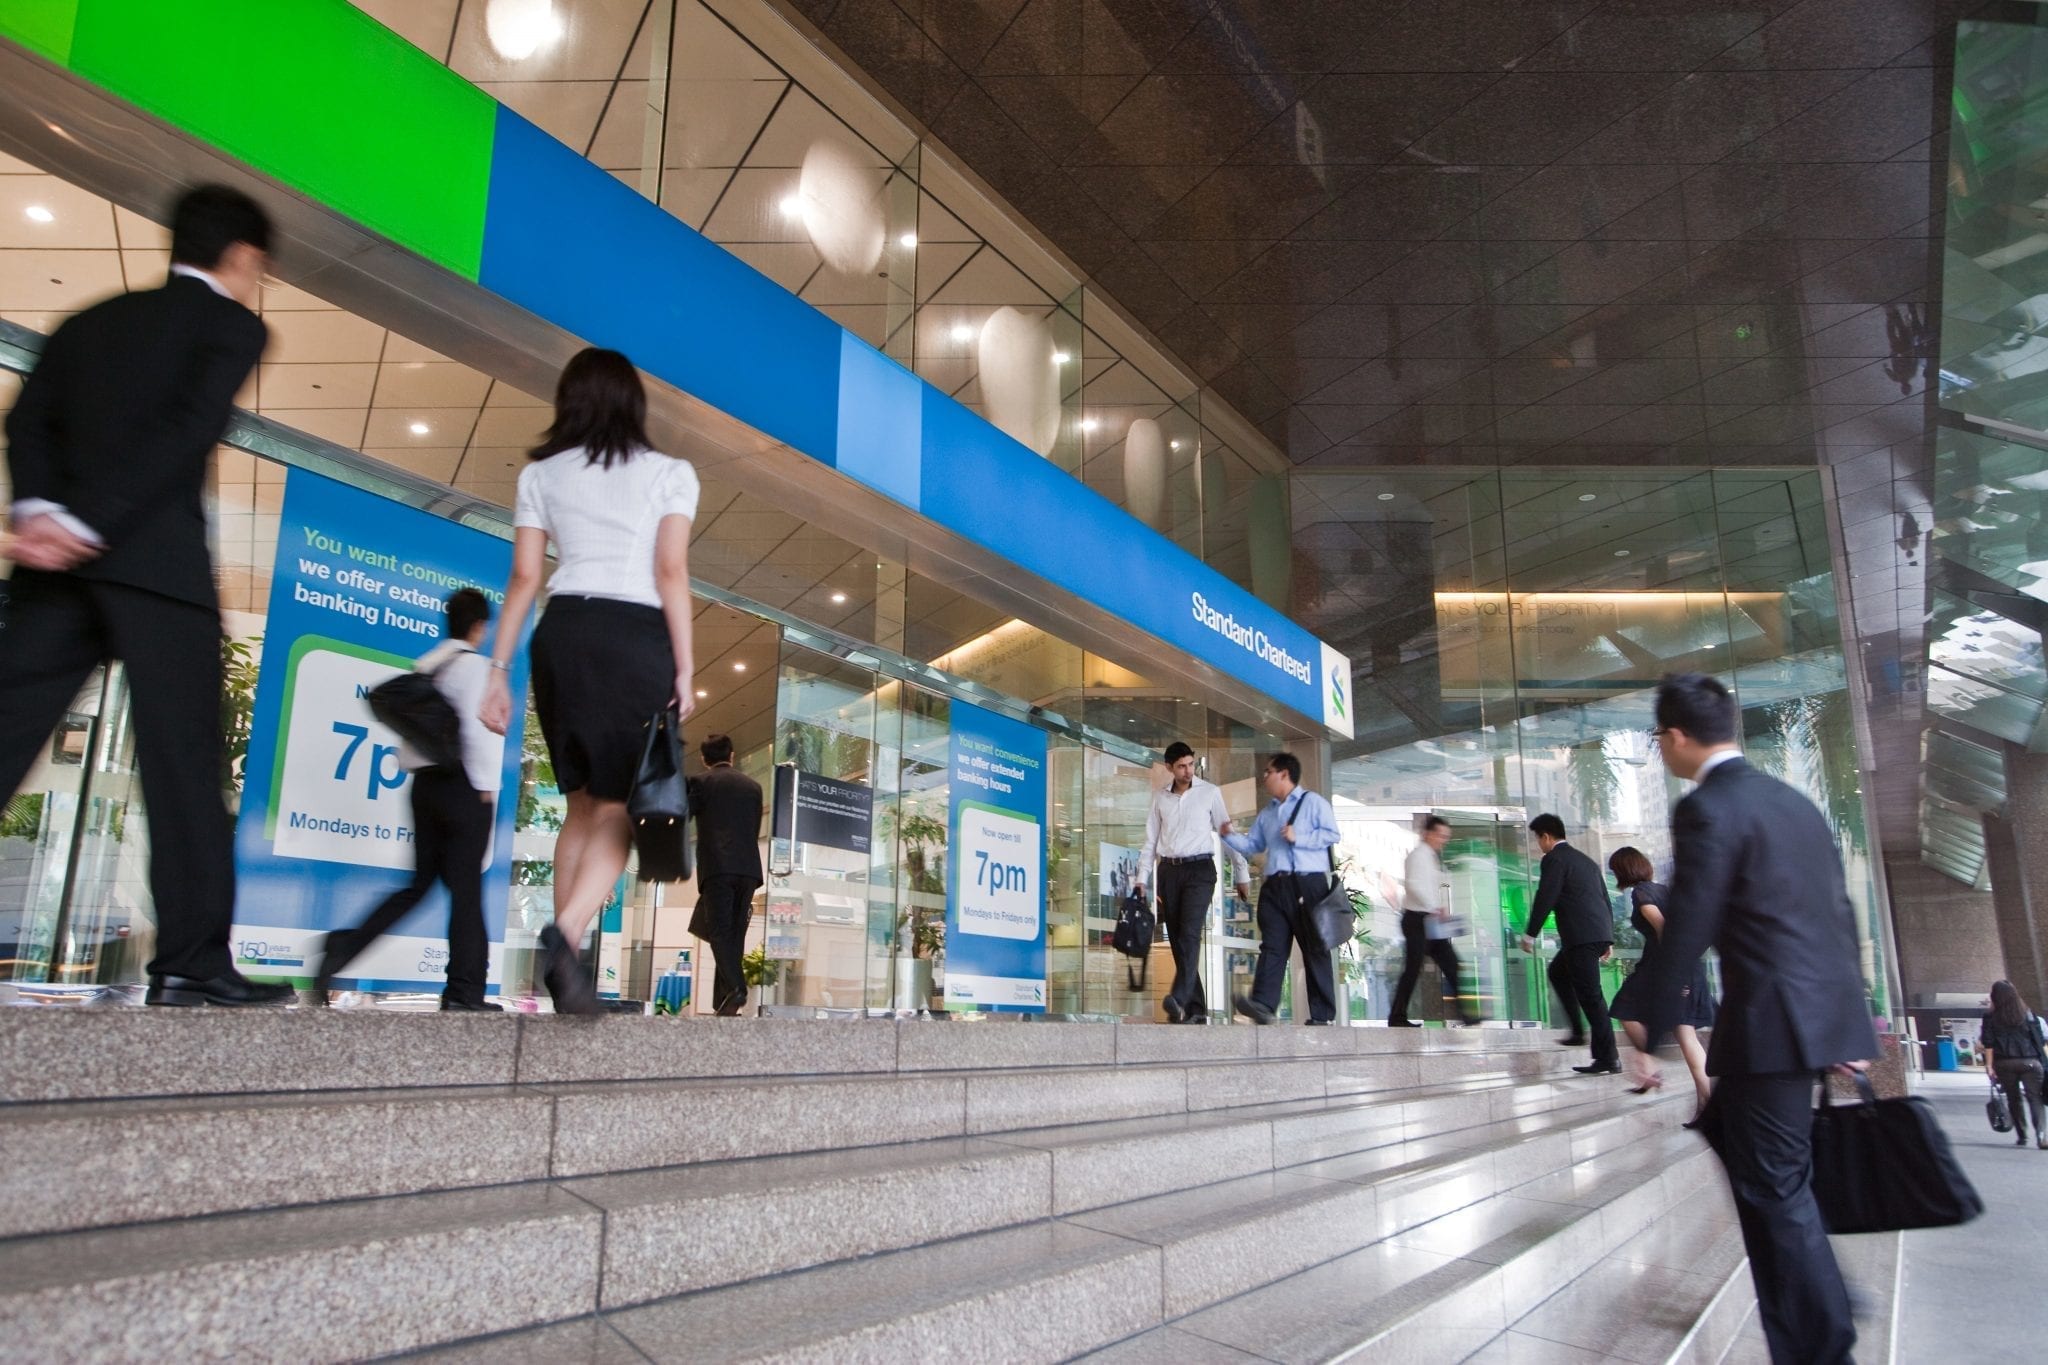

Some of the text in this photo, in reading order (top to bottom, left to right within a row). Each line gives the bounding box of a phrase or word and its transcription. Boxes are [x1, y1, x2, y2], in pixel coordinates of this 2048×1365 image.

[303, 526, 505, 605] You want conveninc
[298, 558, 449, 615] we offer exten
[294, 583, 440, 638] banking hours
[1192, 591, 1312, 686] Standard Chartered
[332, 721, 409, 800] 7p
[957, 753, 1025, 780] we offer extended
[958, 733, 1039, 768] You want convenience
[818, 784, 837, 795] YOUR
[957, 768, 1012, 793] banking hours
[289, 811, 369, 838] Mondays
[375, 824, 391, 840] to
[981, 826, 1021, 844] Now open till
[975, 850, 1026, 896] 7pm
[963, 906, 1037, 928] Mondays to Fridays only
[237, 940, 268, 960] 150
